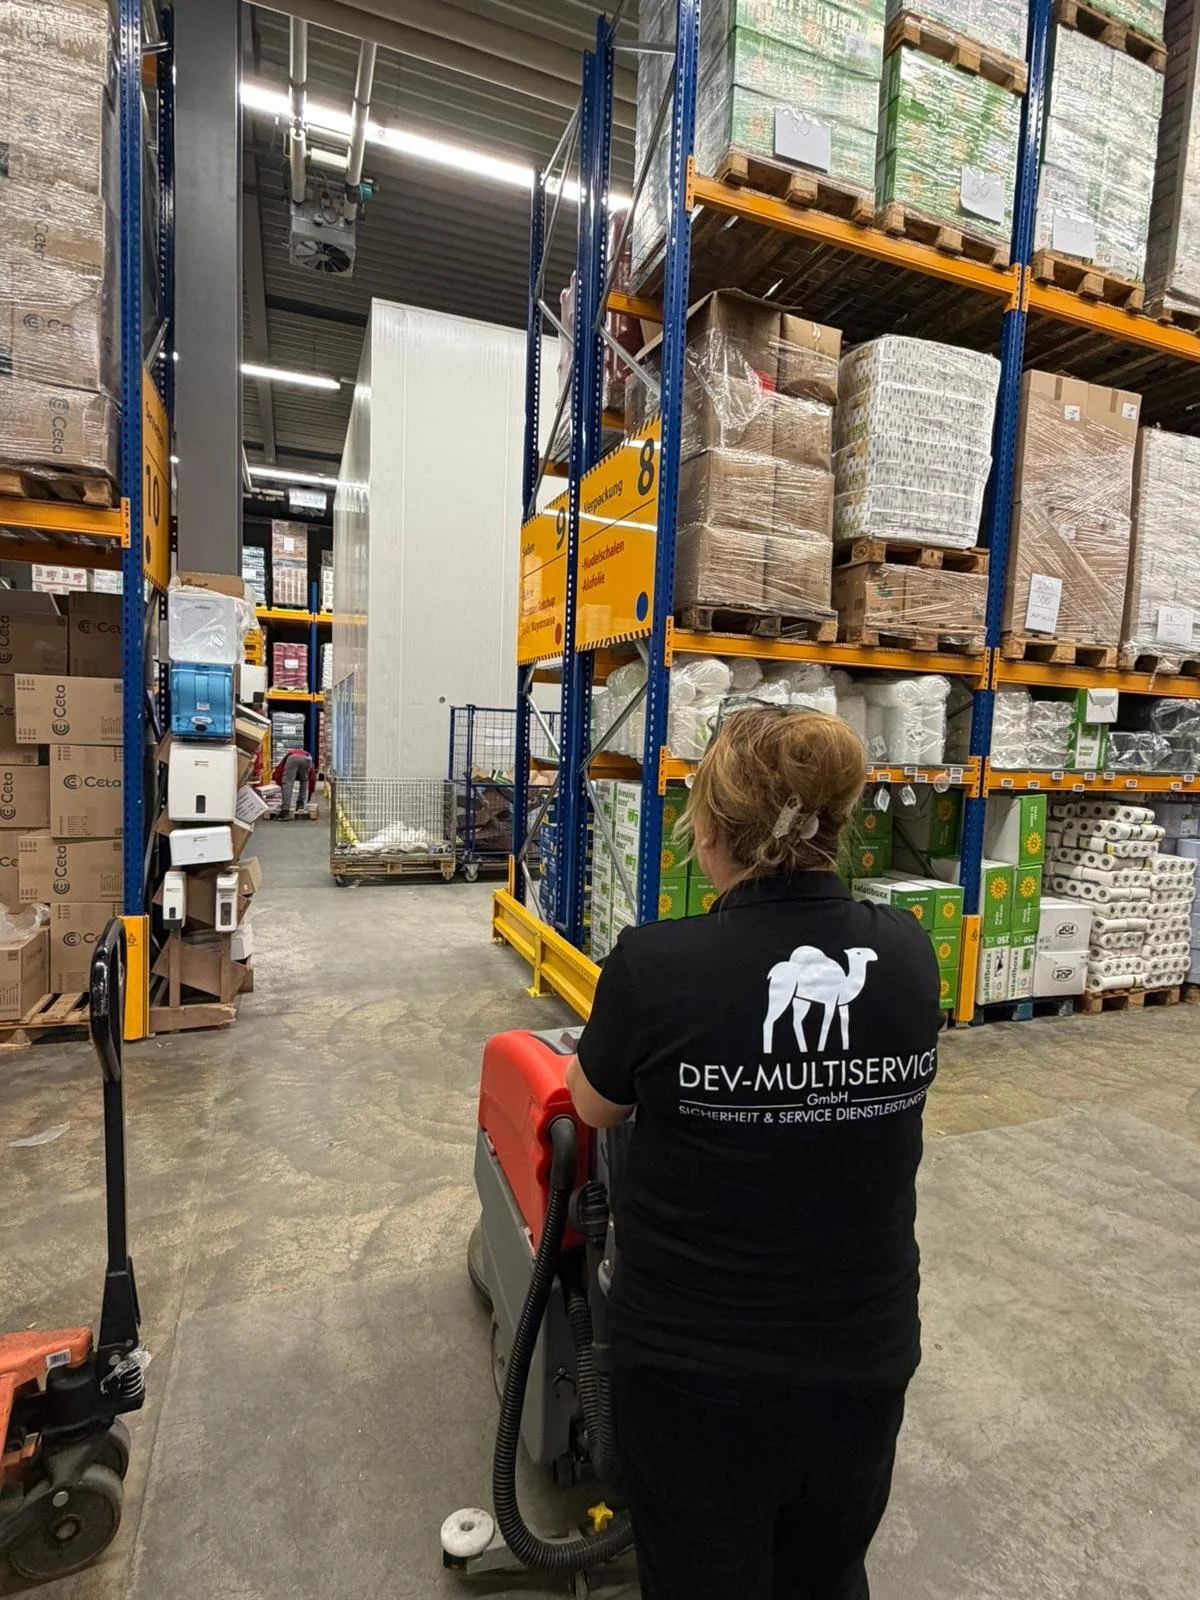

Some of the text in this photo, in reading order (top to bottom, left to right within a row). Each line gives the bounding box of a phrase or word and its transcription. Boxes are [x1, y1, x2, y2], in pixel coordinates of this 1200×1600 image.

[637, 436, 656, 497] 8
[145, 463, 161, 528] 10
[583, 479, 623, 514] Verpackung
[555, 506, 567, 551] 9
[97, 622, 123, 634] Cet
[53, 684, 67, 718] Ceta
[1, 771, 14, 804] Ceta
[84, 776, 122, 788] Ceta
[0, 856, 19, 867] Ce
[54, 845, 68, 878] Ceta
[853, 883, 889, 900] saladboxx
[983, 952, 993, 1002] saladboxx
[1009, 949, 1019, 998] saladboxx
[678, 1047, 936, 1093] DEV-MULTISERVICE
[678, 1105, 761, 1124] SICHERHEIT
[763, 1112, 774, 1124] &
[778, 1107, 832, 1124] SERVICE
[806, 1091, 849, 1106] GmbH
